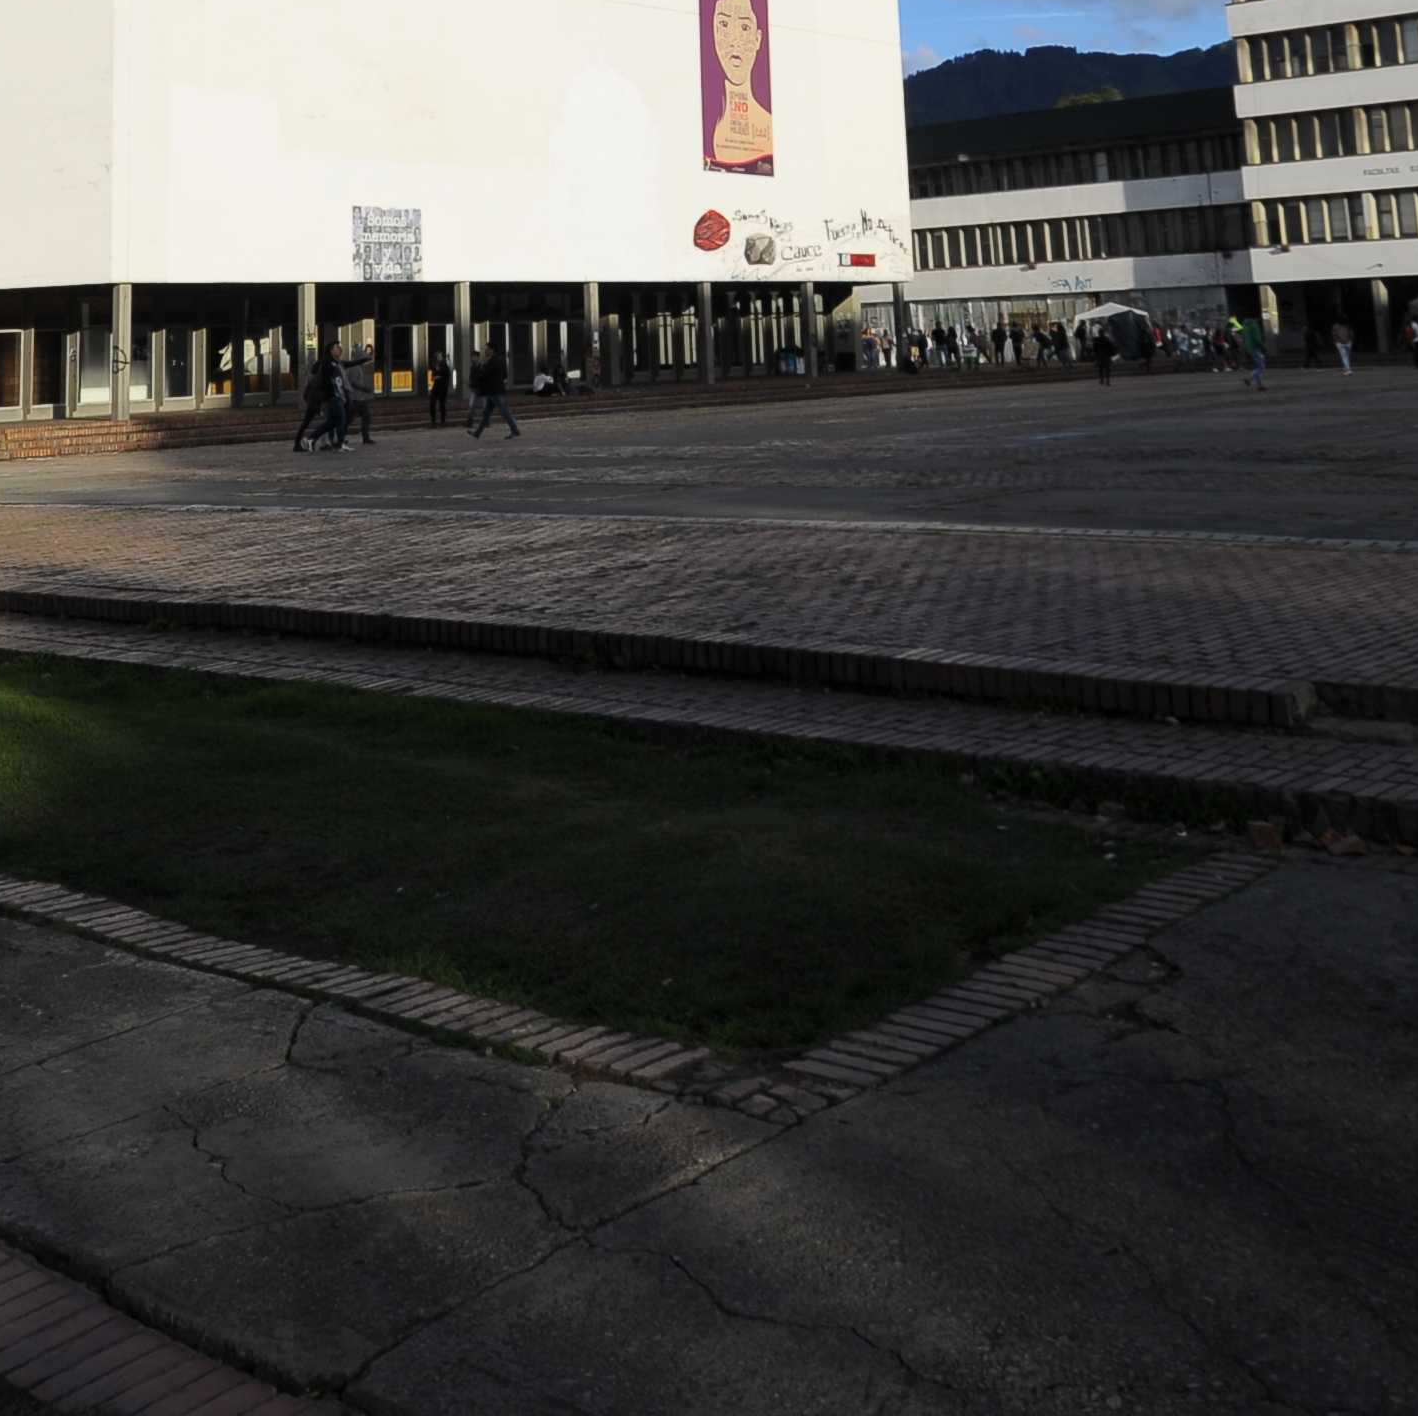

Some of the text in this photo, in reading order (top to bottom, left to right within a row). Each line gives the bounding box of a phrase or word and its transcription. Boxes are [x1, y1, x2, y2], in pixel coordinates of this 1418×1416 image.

[734, 101, 749, 112] NO
[366, 212, 408, 227] Somos
[361, 231, 415, 242] memoria
[383, 248, 392, 261] y
[373, 260, 402, 274] vida
